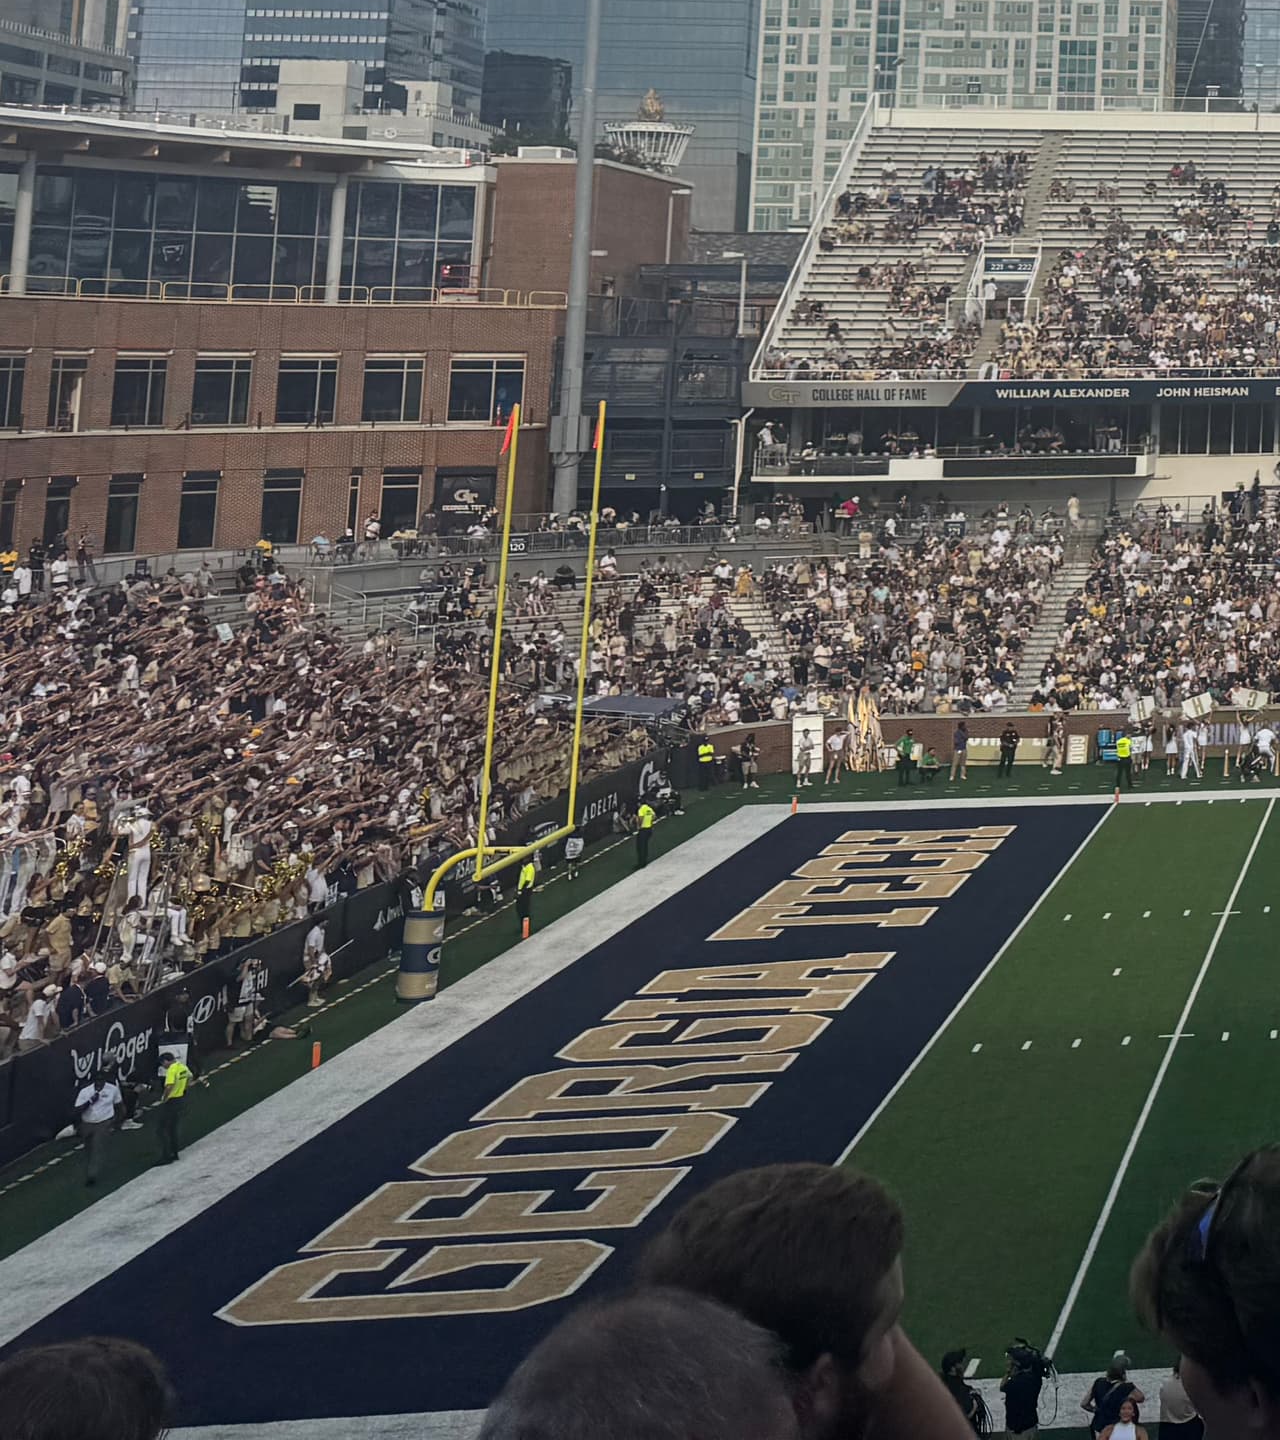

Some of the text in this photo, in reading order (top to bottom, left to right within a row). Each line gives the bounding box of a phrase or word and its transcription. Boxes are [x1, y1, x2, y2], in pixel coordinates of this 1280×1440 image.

[812, 388, 927, 401] COLLEGE HALL OF FAME
[996, 387, 1130, 399] WILLIAM ALEXANDER
[1156, 387, 1249, 397] JOHN HEISMAN
[454, 489, 478, 503] GT
[510, 543, 525, 552] 120
[590, 792, 618, 819] DELTA
[705, 824, 1018, 942] TECH
[214, 951, 896, 1327] GEORGIA
